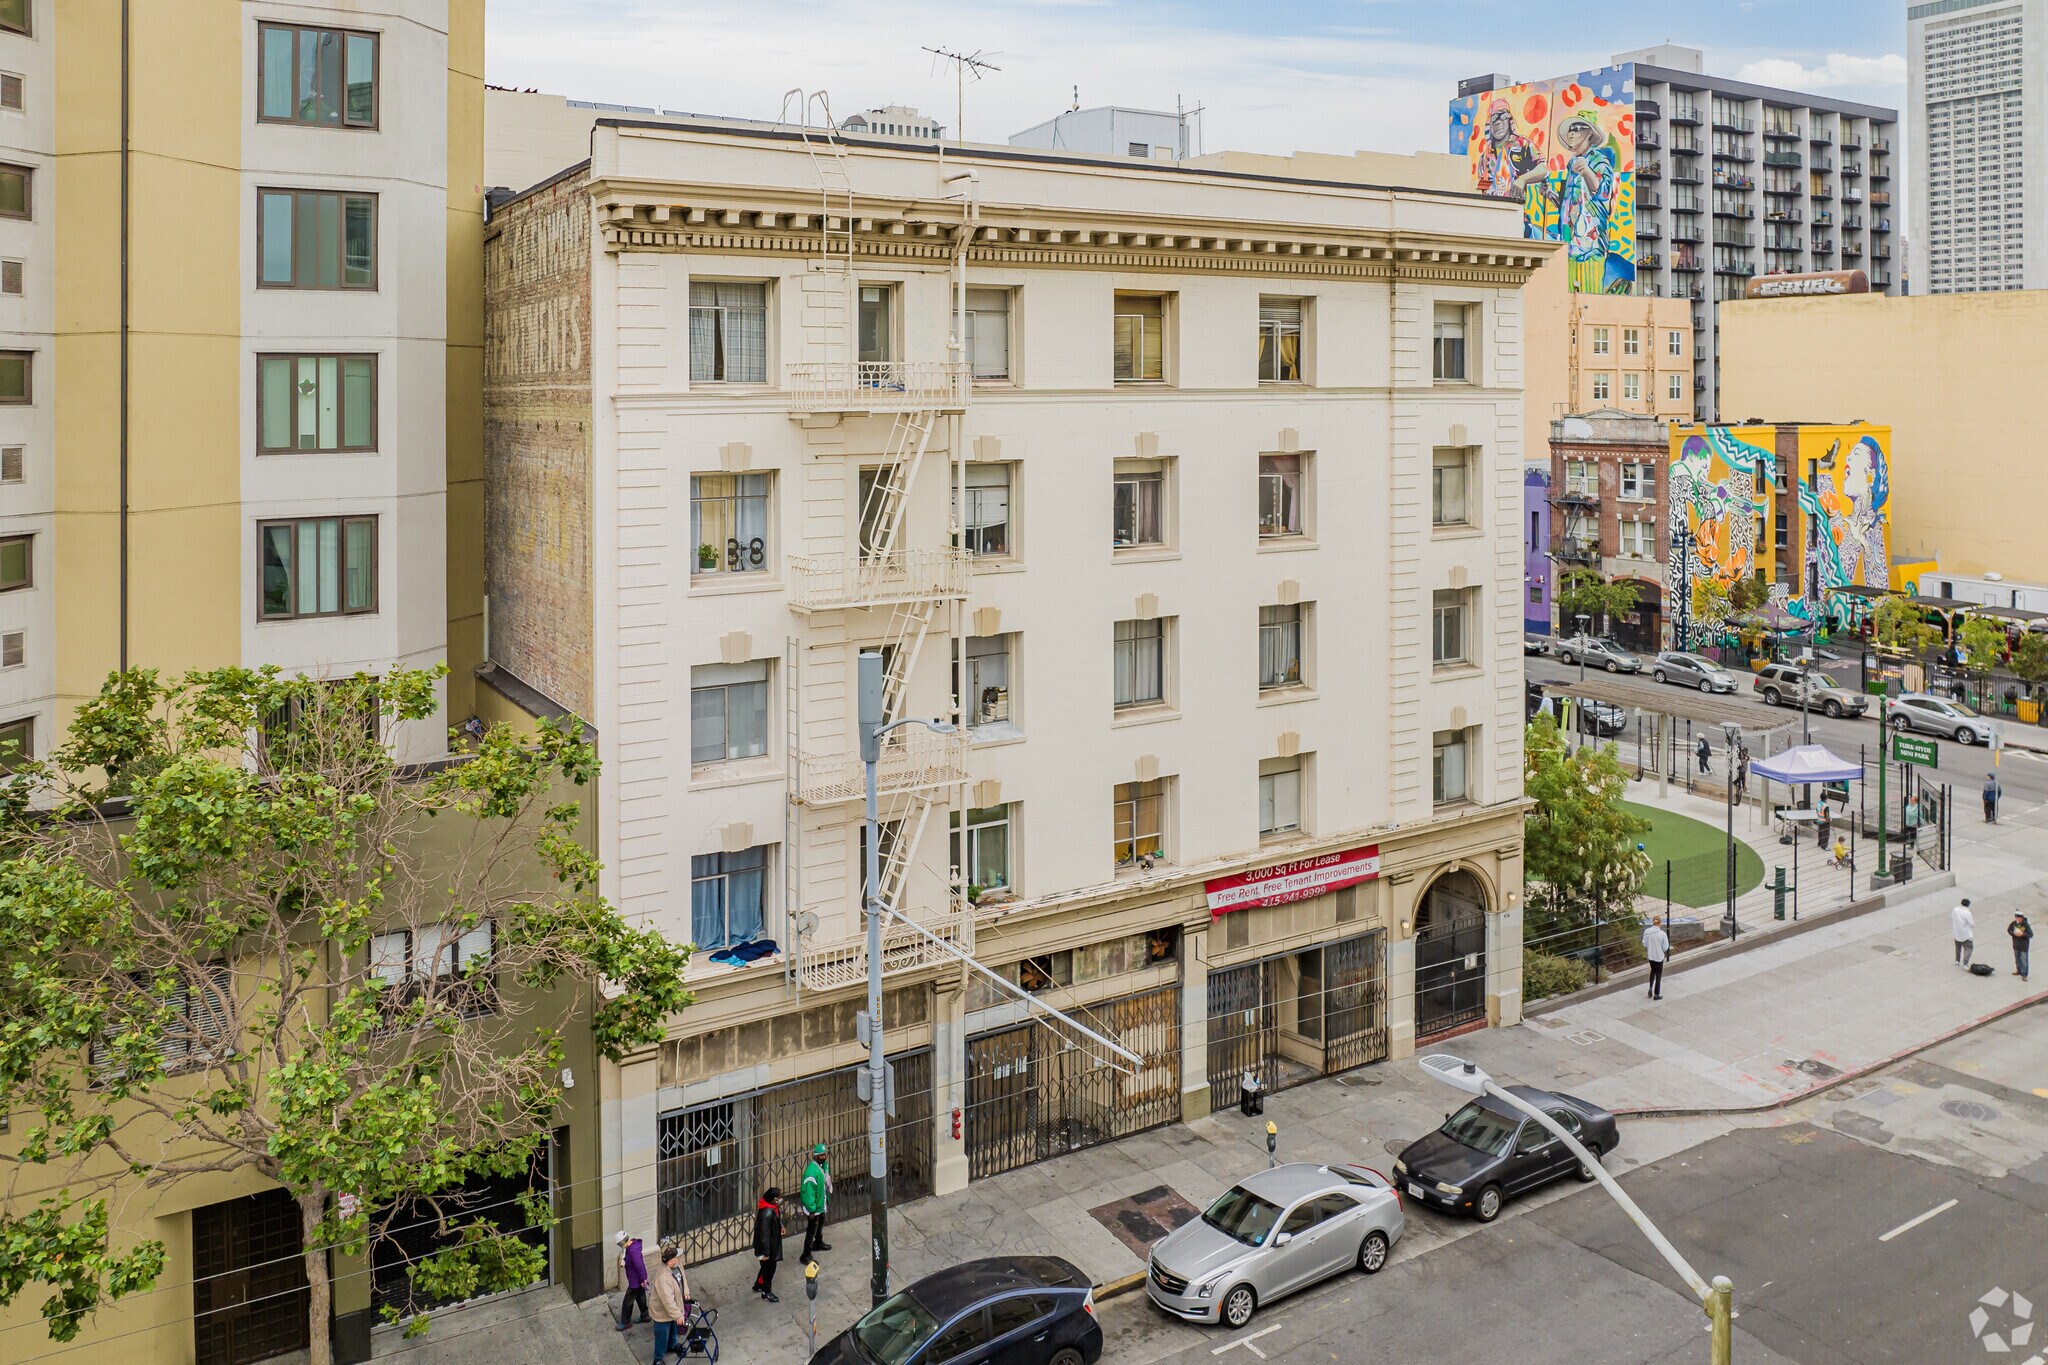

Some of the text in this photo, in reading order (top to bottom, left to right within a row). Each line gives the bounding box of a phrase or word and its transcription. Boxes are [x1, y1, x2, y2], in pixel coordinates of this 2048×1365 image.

[484, 293, 582, 378] APARTMENTS
[1899, 742, 1931, 753] TURK-HYDE
[1914, 752, 1930, 760] PARK
[1246, 853, 1341, 882] 3,000 Sq Ft For Lease
[1217, 861, 1373, 904] Free Rent, Free Tenant Improvements
[1262, 885, 1327, 907] 415-241-9999
